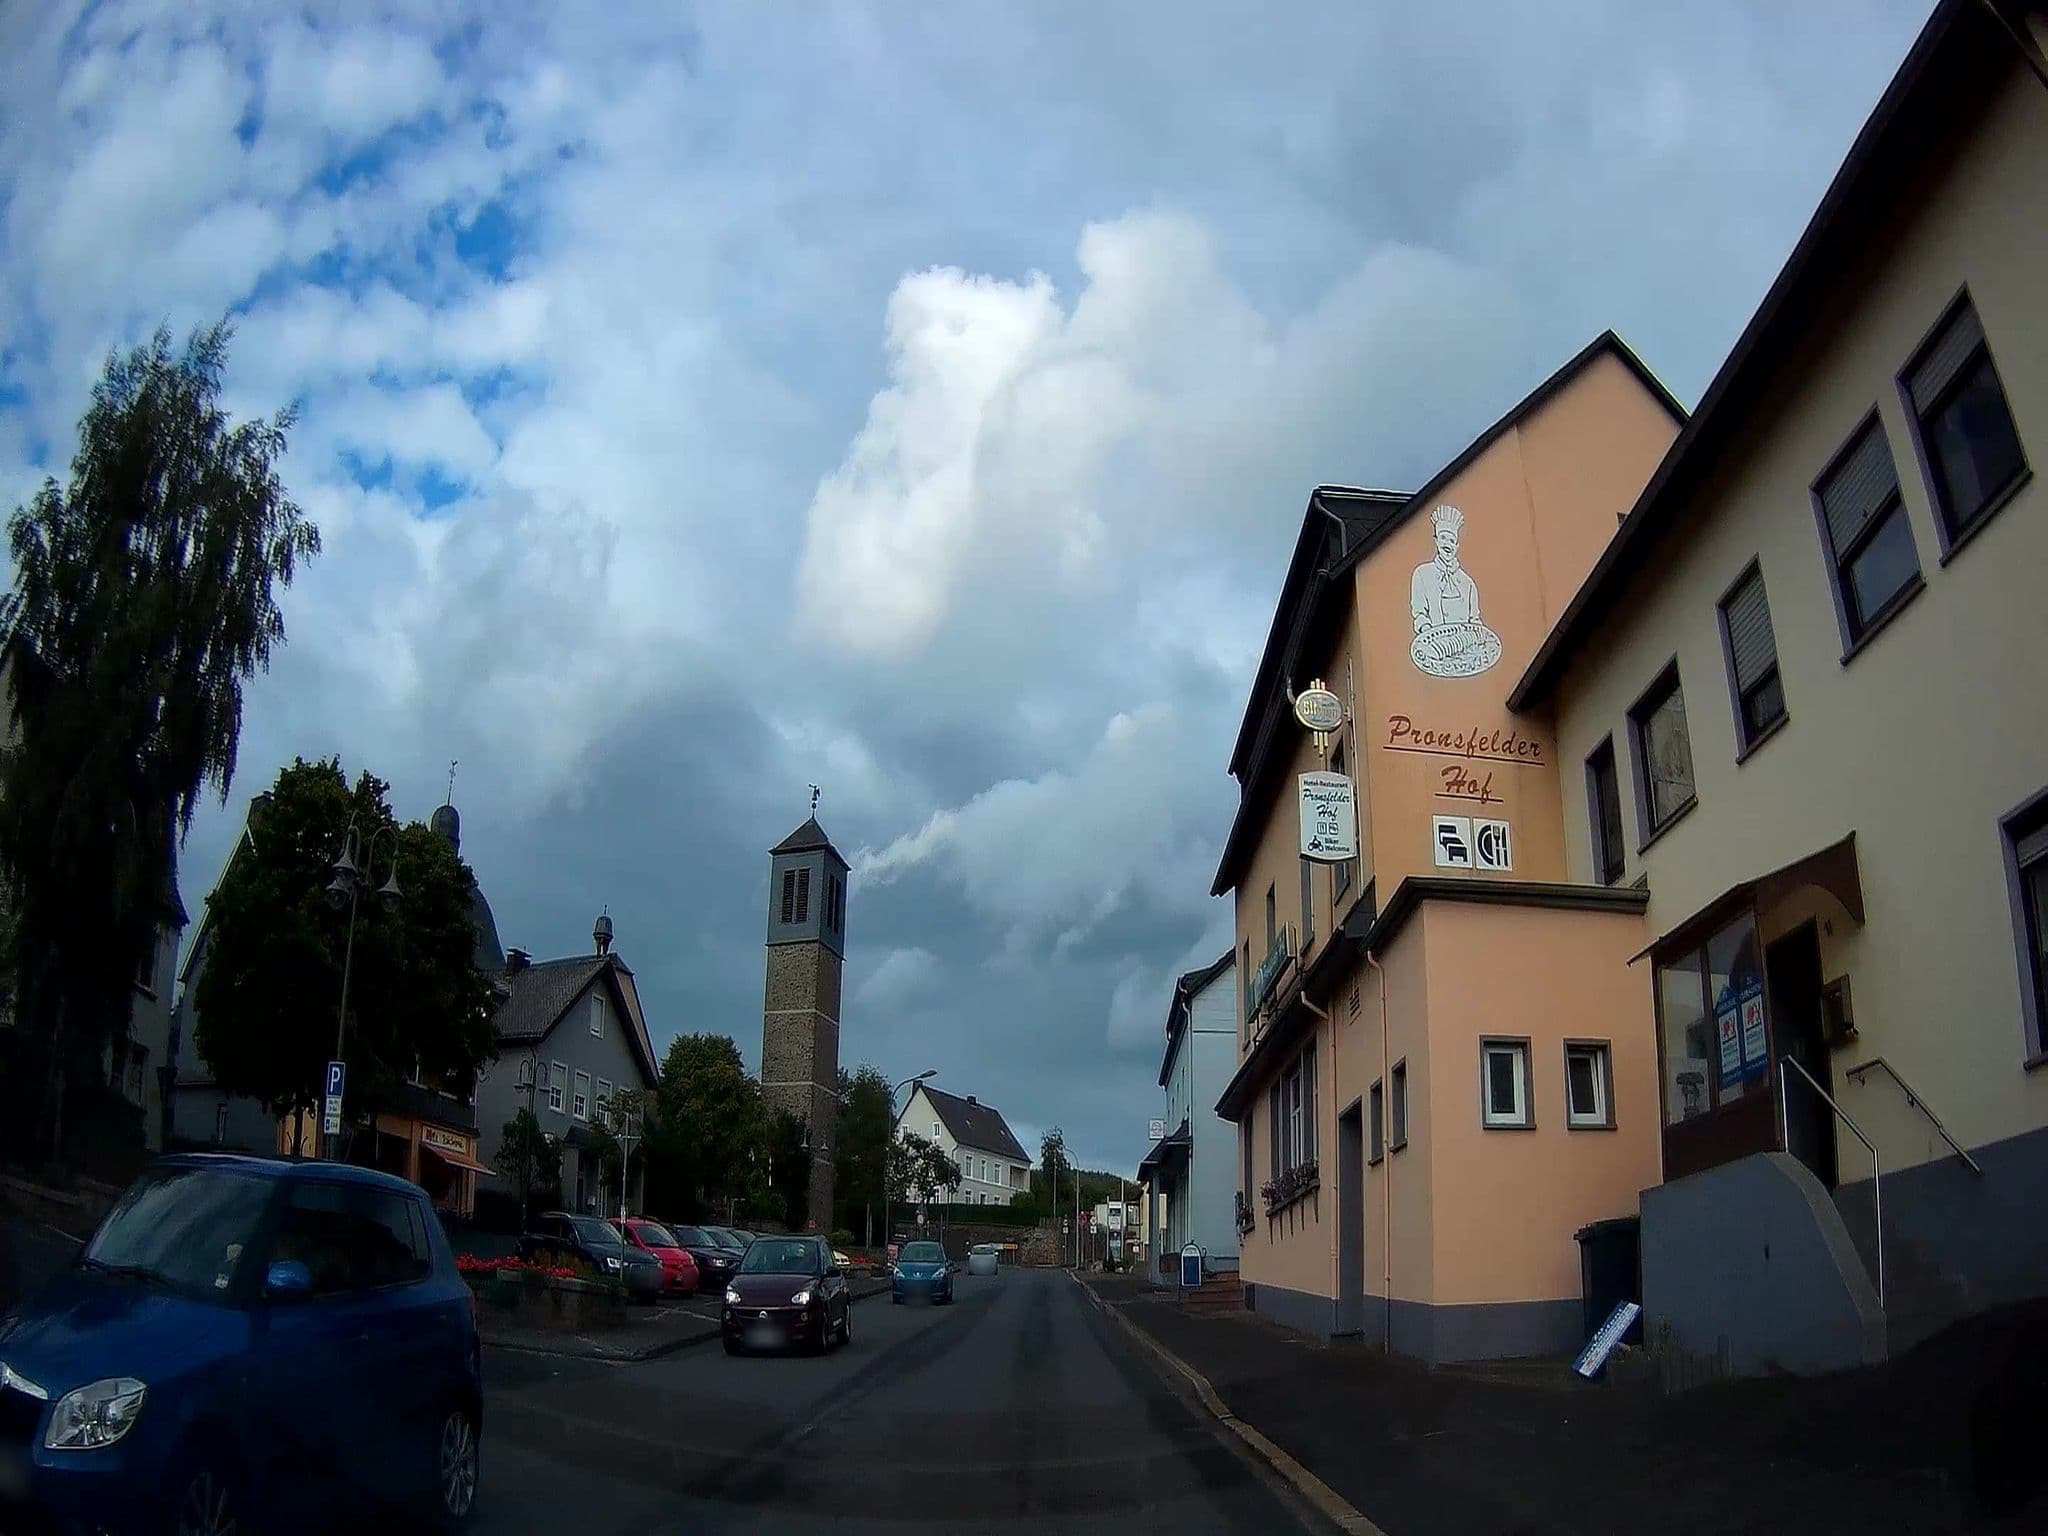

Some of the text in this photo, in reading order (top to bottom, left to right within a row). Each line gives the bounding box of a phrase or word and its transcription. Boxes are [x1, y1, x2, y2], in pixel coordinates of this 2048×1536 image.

[1389, 715, 1541, 758] Pronsfelder
[1303, 788, 1350, 805] Pronsfelder
[1441, 765, 1492, 804] Hof
[1316, 804, 1338, 821] Hof
[330, 1067, 341, 1093] P
